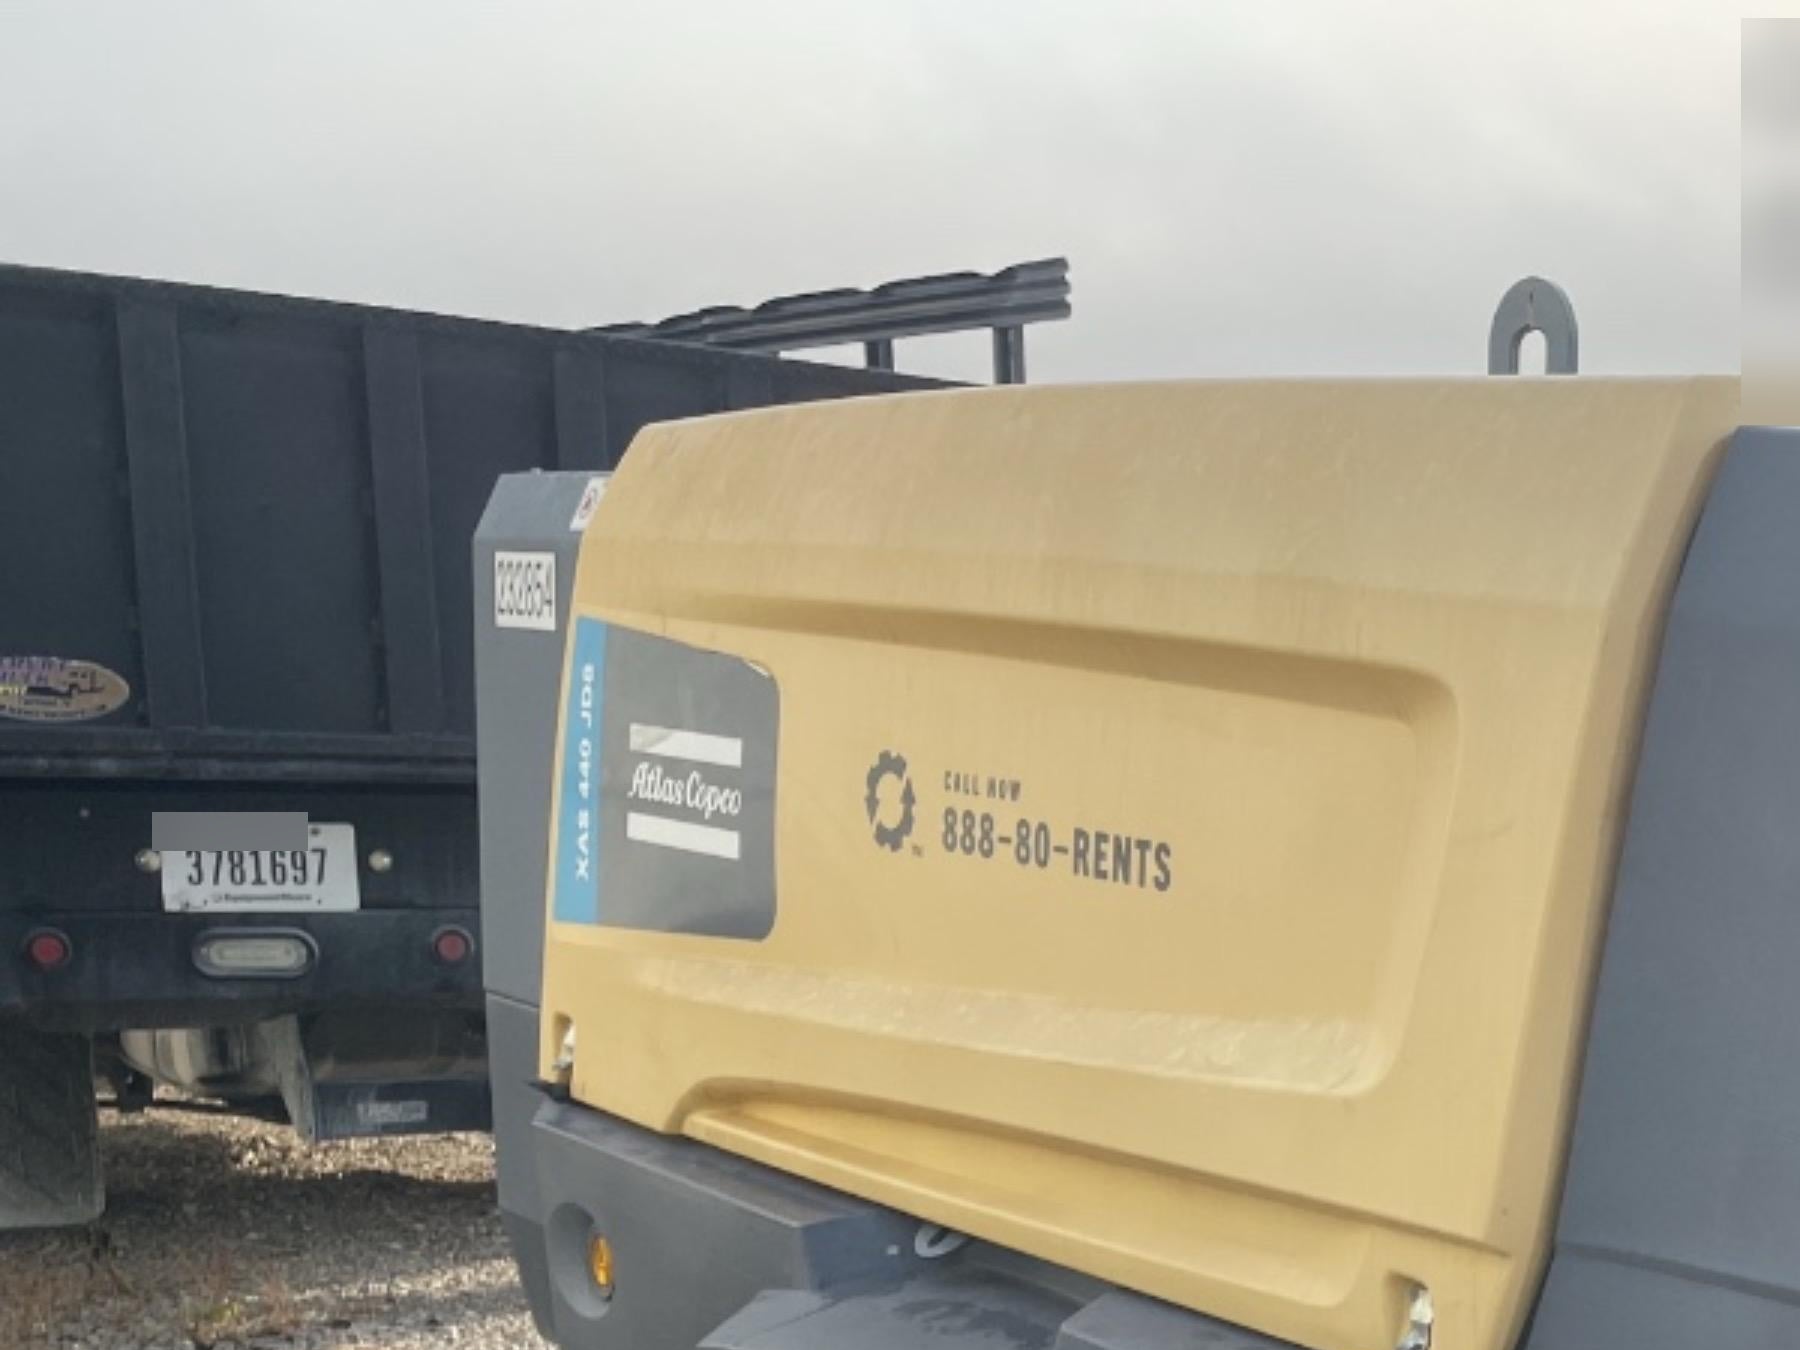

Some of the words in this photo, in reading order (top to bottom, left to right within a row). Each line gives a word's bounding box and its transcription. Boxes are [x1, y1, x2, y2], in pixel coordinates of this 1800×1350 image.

[579, 738, 592, 799] 440
[627, 761, 684, 806] Atlas
[686, 771, 742, 819] Copco
[944, 770, 979, 796] CALL
[986, 777, 1021, 801] NOW
[186, 848, 328, 885] 3781697
[576, 809, 590, 881] XAS
[942, 806, 1172, 892] 888-80-RENTS
